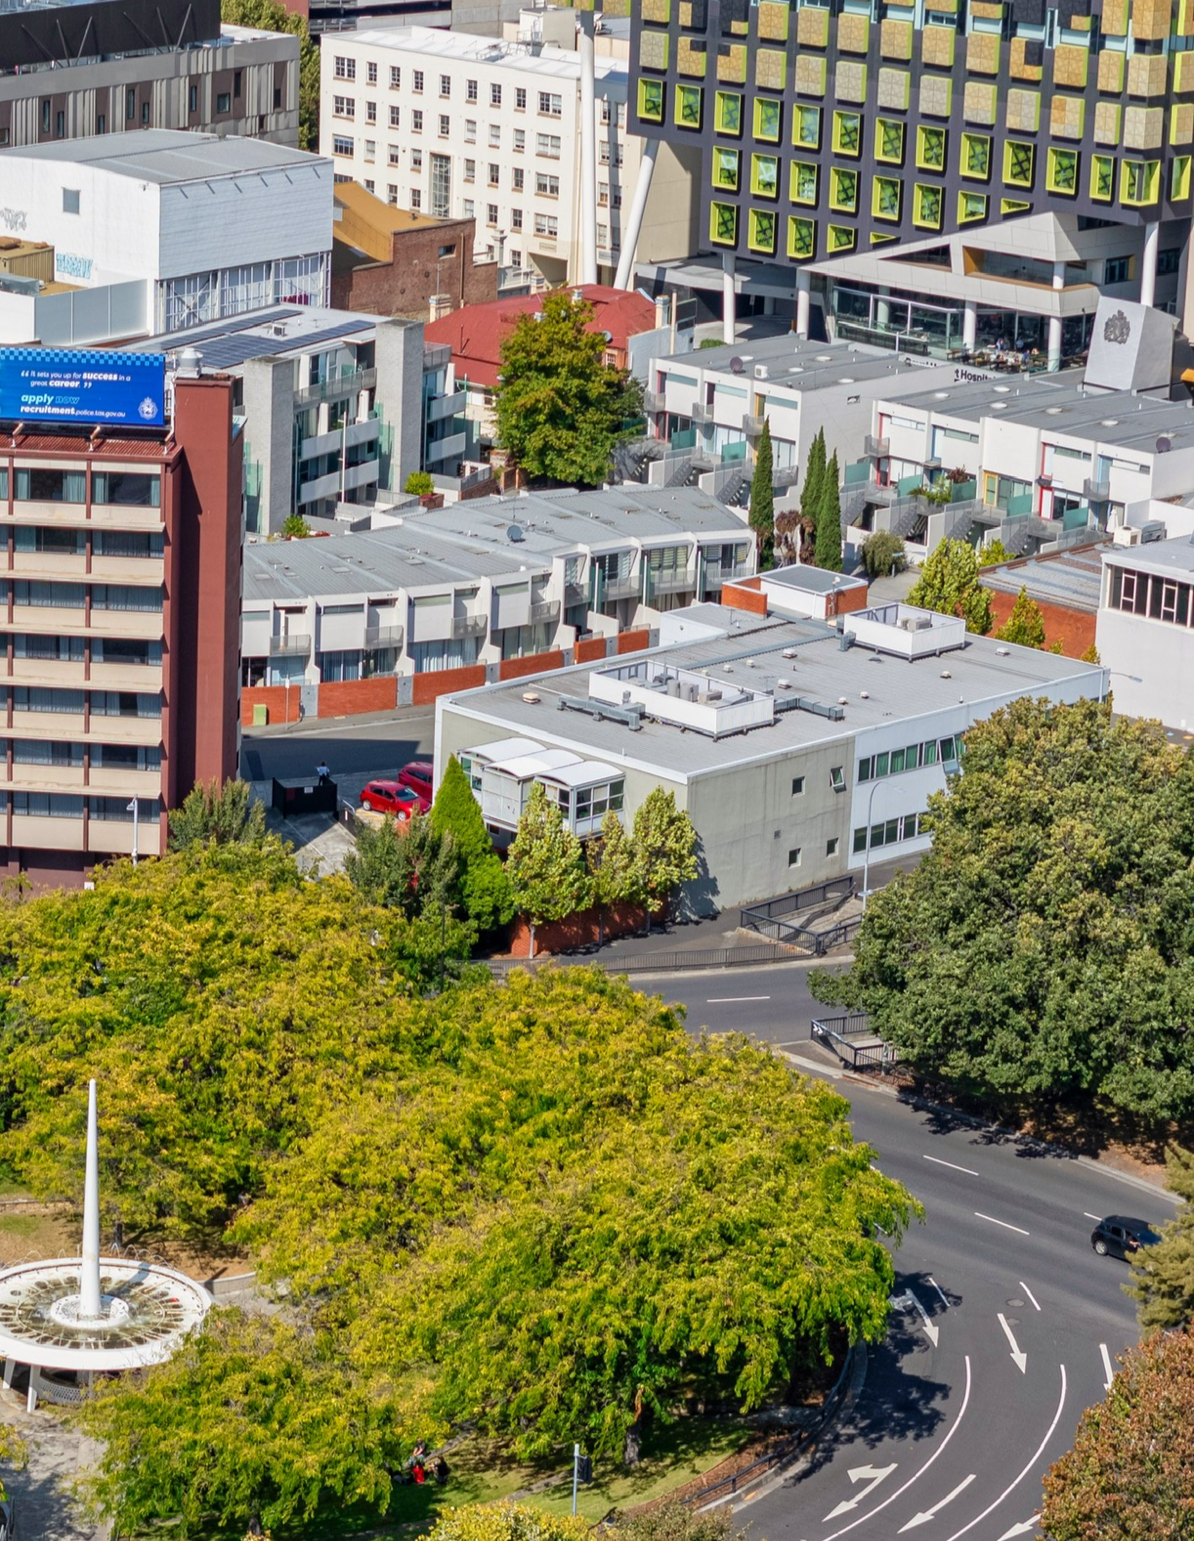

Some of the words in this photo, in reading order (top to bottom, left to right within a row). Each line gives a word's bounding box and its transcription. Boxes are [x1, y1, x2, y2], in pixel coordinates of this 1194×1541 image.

[82, 372, 118, 381] success
[21, 393, 54, 405] apply
[55, 396, 80, 404] now
